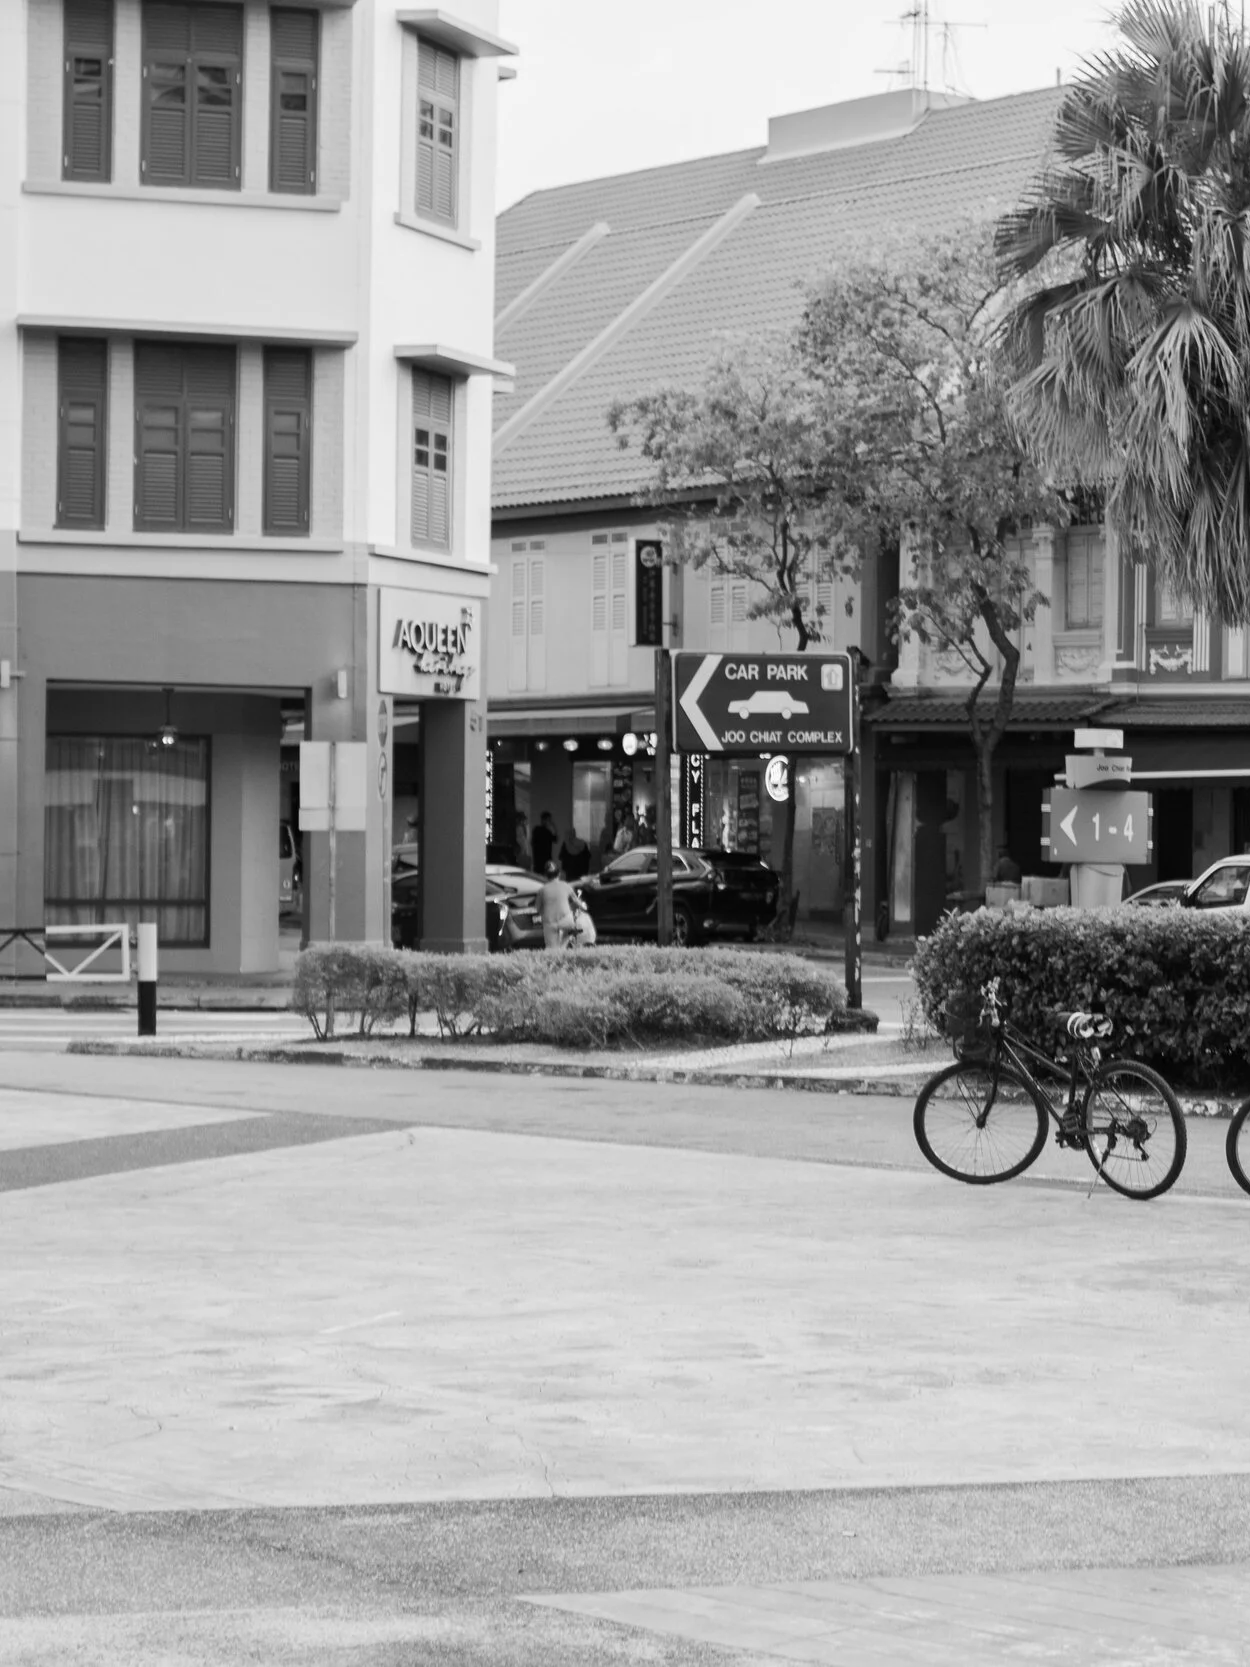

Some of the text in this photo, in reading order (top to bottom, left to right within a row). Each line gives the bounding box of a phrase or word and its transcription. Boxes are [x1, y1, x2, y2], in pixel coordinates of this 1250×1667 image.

[393, 618, 468, 655] AQUEEN
[725, 663, 809, 681] CAR PARK
[721, 730, 843, 744] JOO CHIAT COMPLEX
[1096, 763, 1109, 772] Joo
[1092, 812, 1100, 842] 1
[1123, 813, 1134, 843] 4
